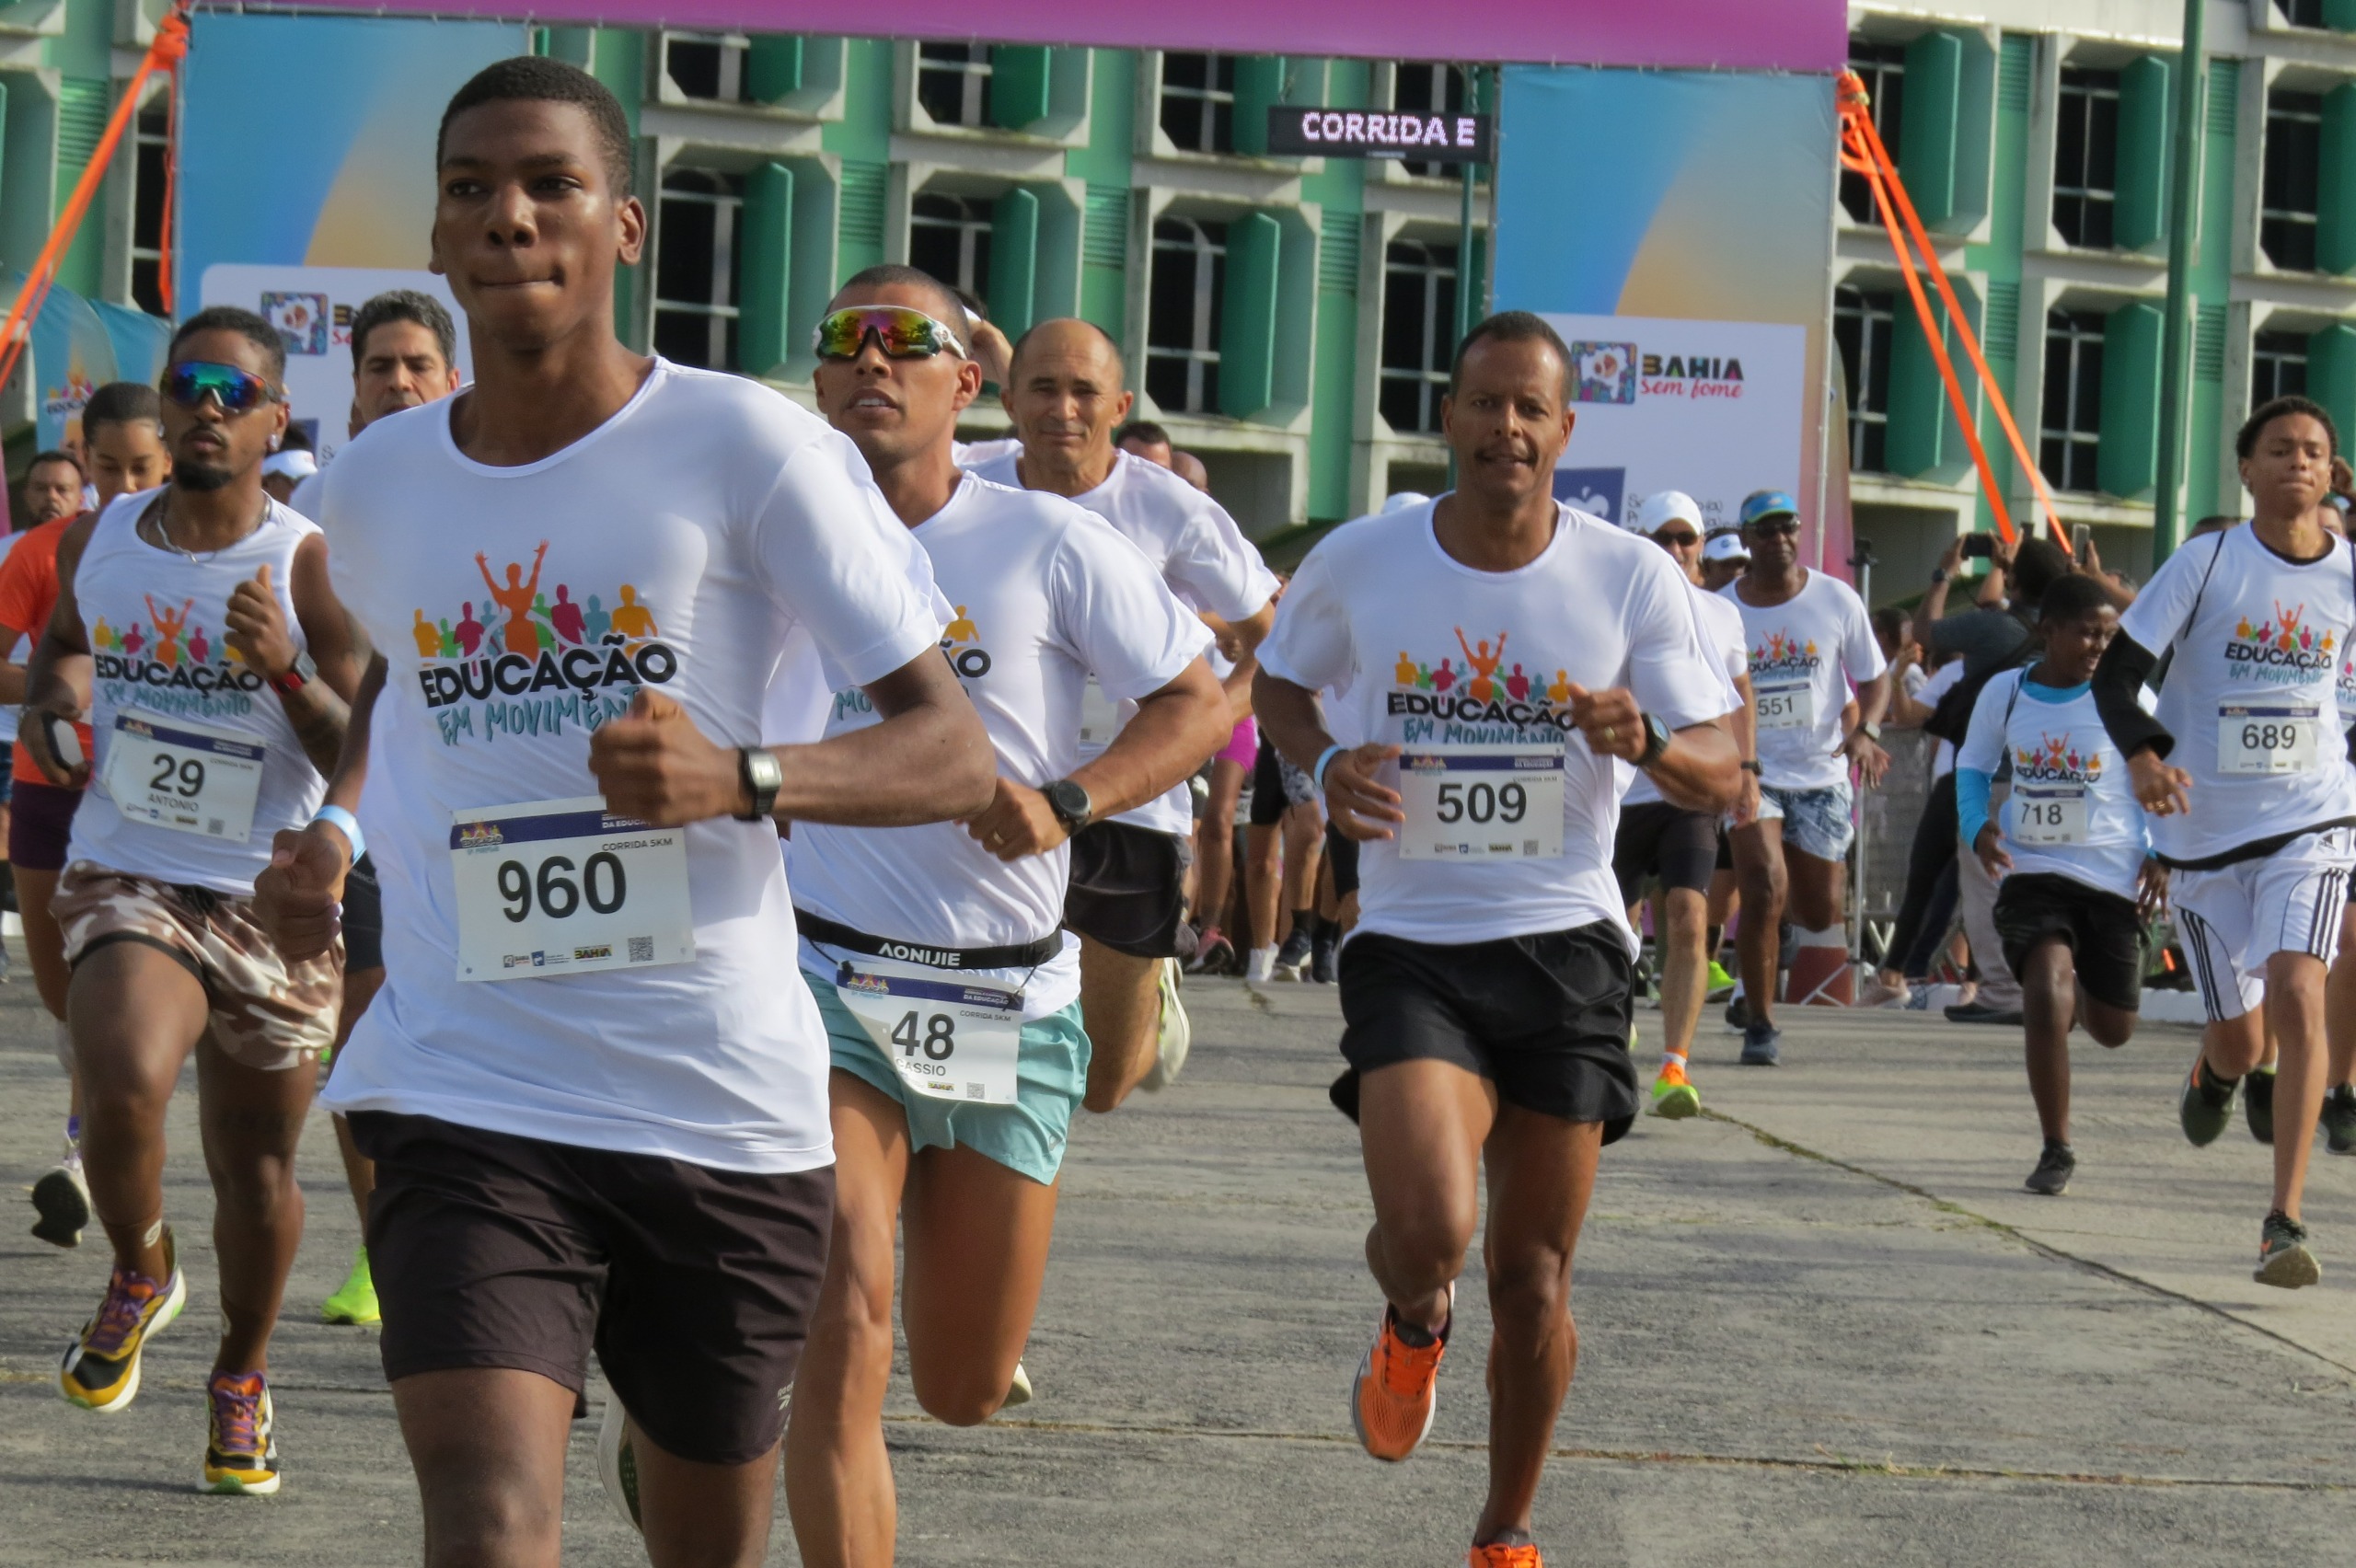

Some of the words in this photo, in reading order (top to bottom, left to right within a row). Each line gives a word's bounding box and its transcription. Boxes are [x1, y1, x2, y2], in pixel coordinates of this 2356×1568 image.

[1302, 111, 1448, 145] CORRIDA
[1457, 118, 1475, 146] E
[1642, 353, 1743, 380] BAHIA
[1640, 378, 1683, 396] sem
[1690, 378, 1742, 398] fome
[2224, 641, 2332, 673] EDUCAÇÃO
[95, 654, 264, 698] EDUCAÇÃO
[419, 634, 677, 708] EDUCAÇÃO
[2230, 663, 2250, 680] EM
[436, 706, 474, 746] EM
[485, 686, 641, 743] MOVIMENT
[1387, 691, 1577, 732] EDUCAÇÃO
[1758, 696, 1793, 716] 551
[1403, 717, 1434, 744] EM
[2242, 723, 2296, 750] 689
[150, 753, 204, 798] 29
[147, 793, 200, 813] ANTONIO
[1437, 782, 1527, 824] 509
[2021, 802, 2062, 825] 718
[602, 839, 648, 851] CORRIDA
[649, 837, 673, 847] 5KM
[497, 851, 627, 923] 960
[878, 942, 961, 966] AONIJIE
[960, 1010, 993, 1020] CORRIDA
[994, 1014, 1011, 1022] 5KM
[891, 1009, 955, 1061] 48
[895, 1058, 946, 1077] CASSIO
